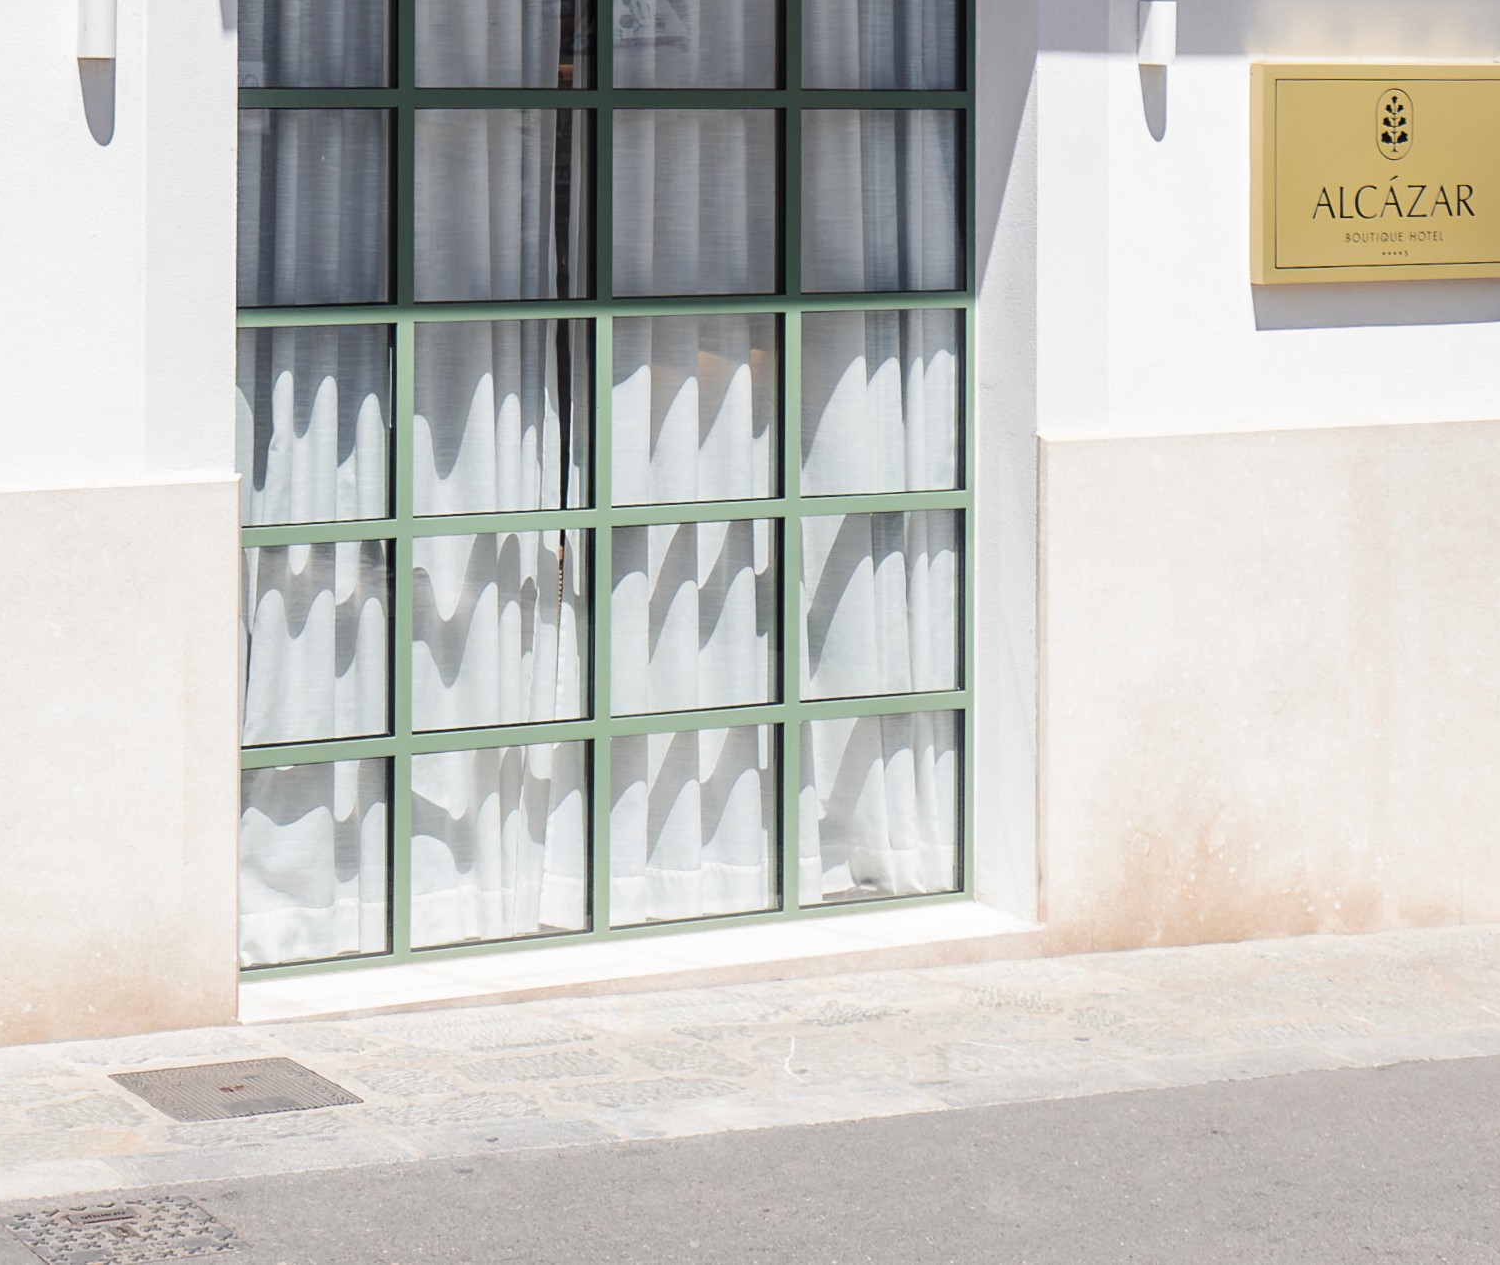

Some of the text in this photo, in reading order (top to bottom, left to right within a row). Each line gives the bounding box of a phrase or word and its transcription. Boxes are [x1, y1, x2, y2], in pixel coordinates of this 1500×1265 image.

[1312, 175, 1476, 219] ALCÁZAR
[1345, 230, 1444, 243] BOUTIQUE HOTEL
